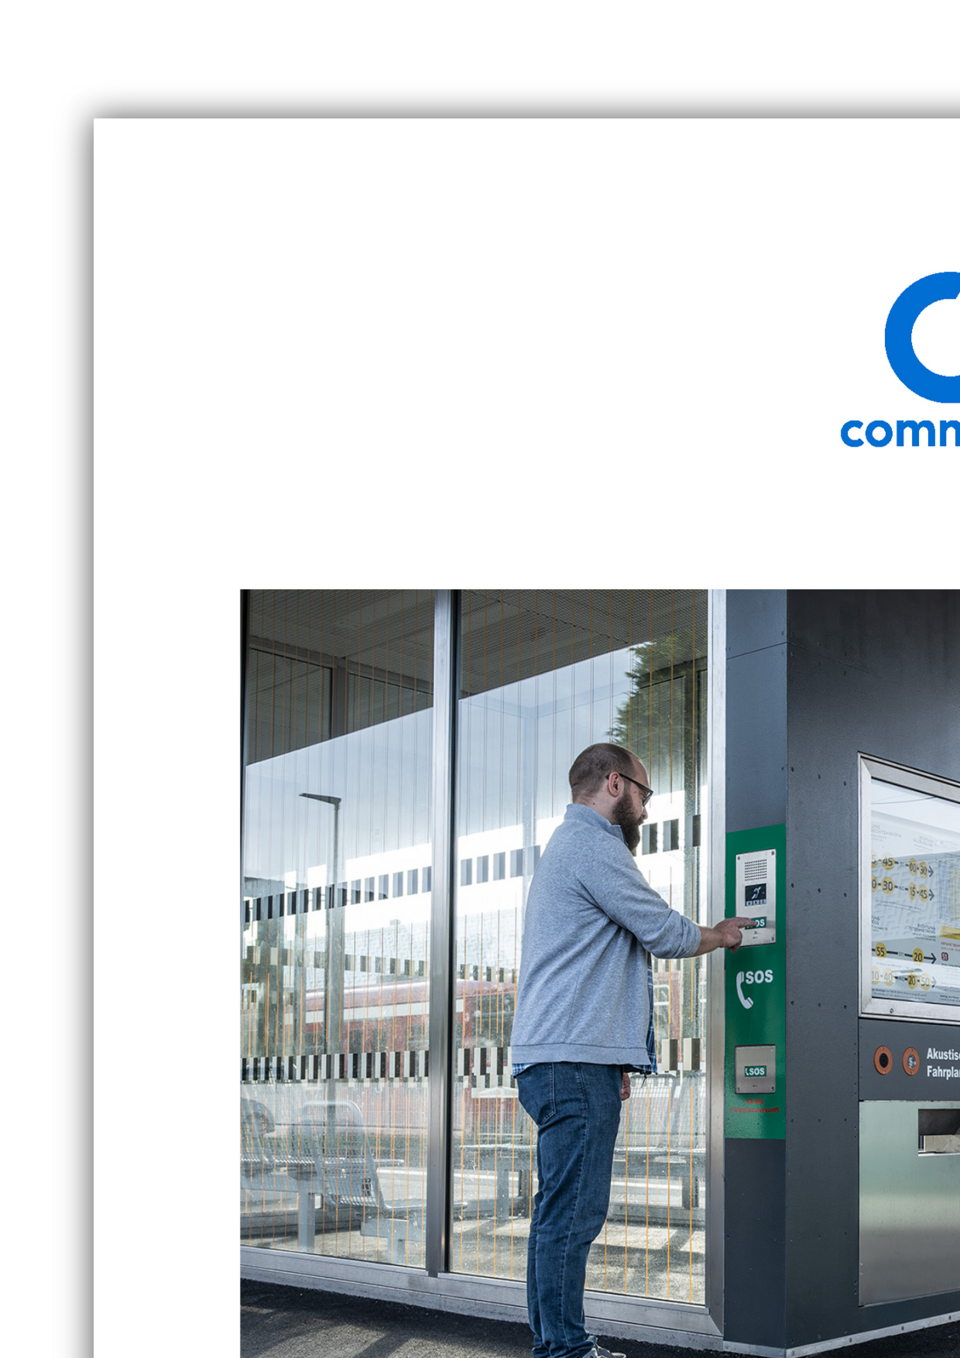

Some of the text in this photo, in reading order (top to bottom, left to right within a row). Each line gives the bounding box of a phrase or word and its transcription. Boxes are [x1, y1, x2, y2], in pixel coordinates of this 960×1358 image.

[882, 857, 893, 867] 45
[882, 880, 894, 891] 30
[919, 889, 928, 899] 45
[876, 946, 923, 963] 55 20
[745, 969, 774, 985] SOS
[883, 972, 894, 983] 40
[908, 975, 917, 986] 20
[921, 976, 931, 987] 50
[749, 1067, 765, 1076] SOS
[730, 1106, 780, 1114] Fahrplanauskunft
